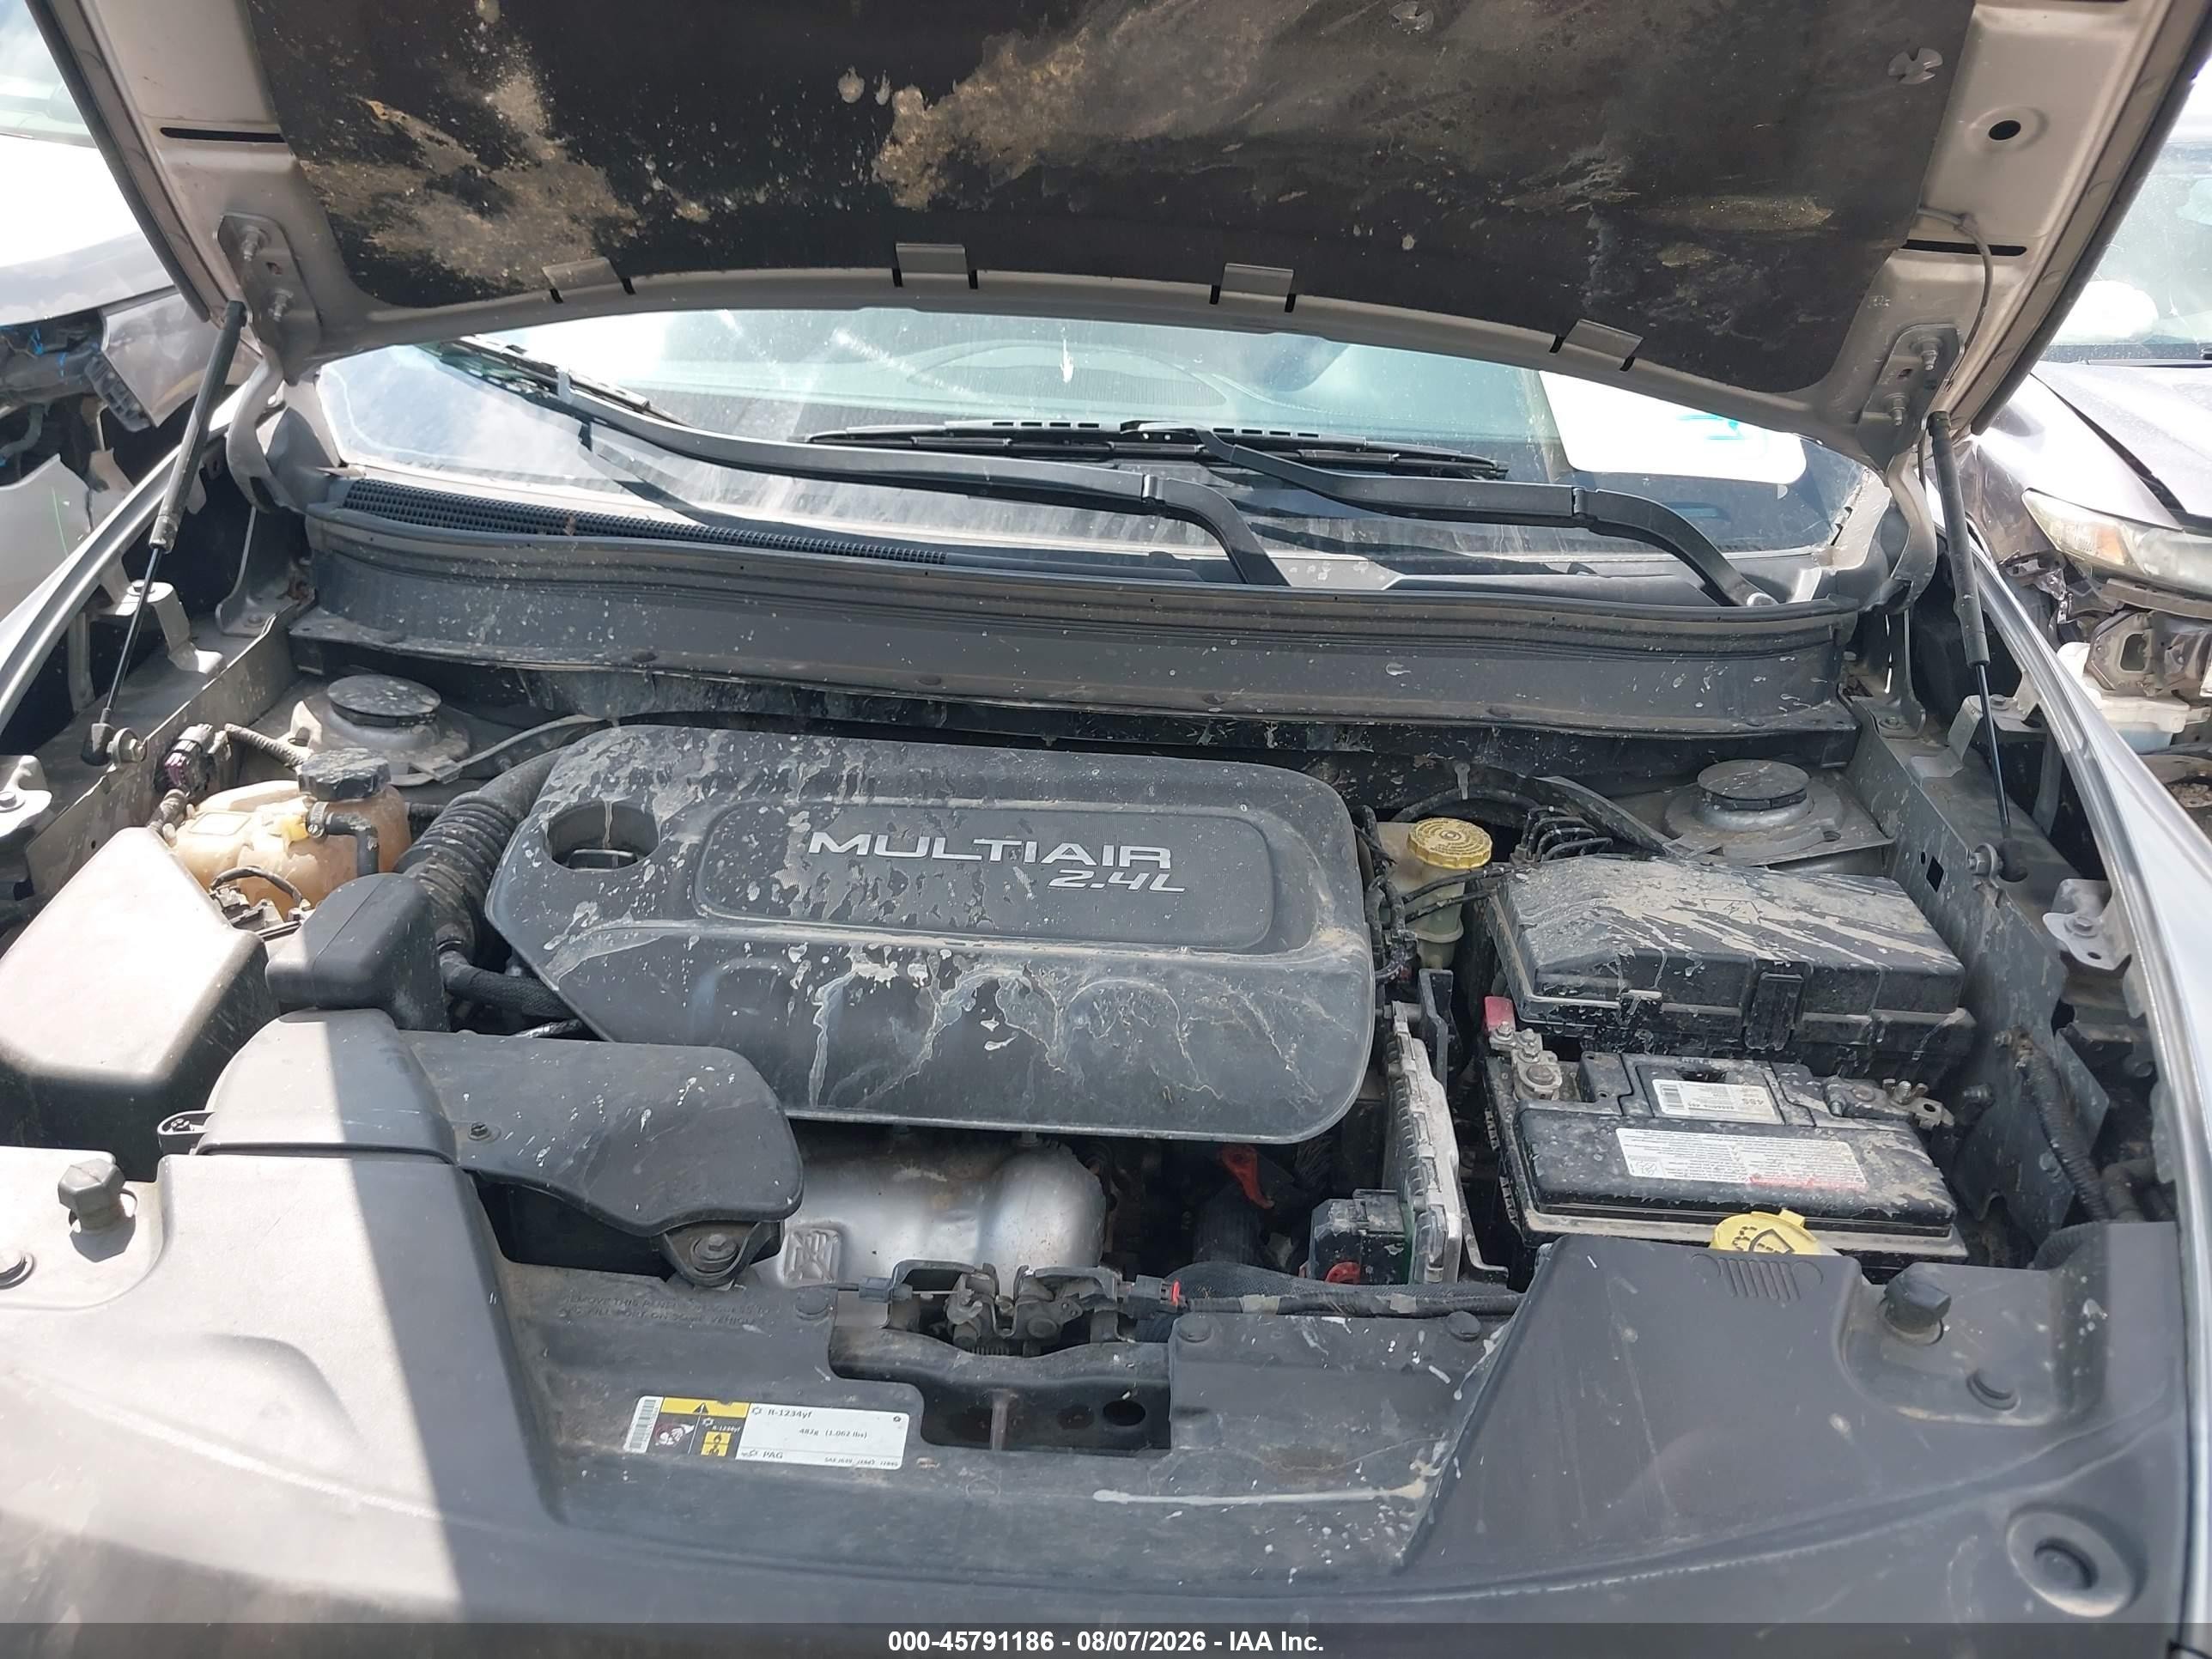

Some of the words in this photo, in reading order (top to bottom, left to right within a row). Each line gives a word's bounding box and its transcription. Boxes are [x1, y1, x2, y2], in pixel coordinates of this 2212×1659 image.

[807, 831, 1171, 870] MULTIAIR
[1047, 869, 1185, 893] 2.4L
[767, 1408, 812, 1419] R-1234yf
[763, 1450, 784, 1459] PAG
